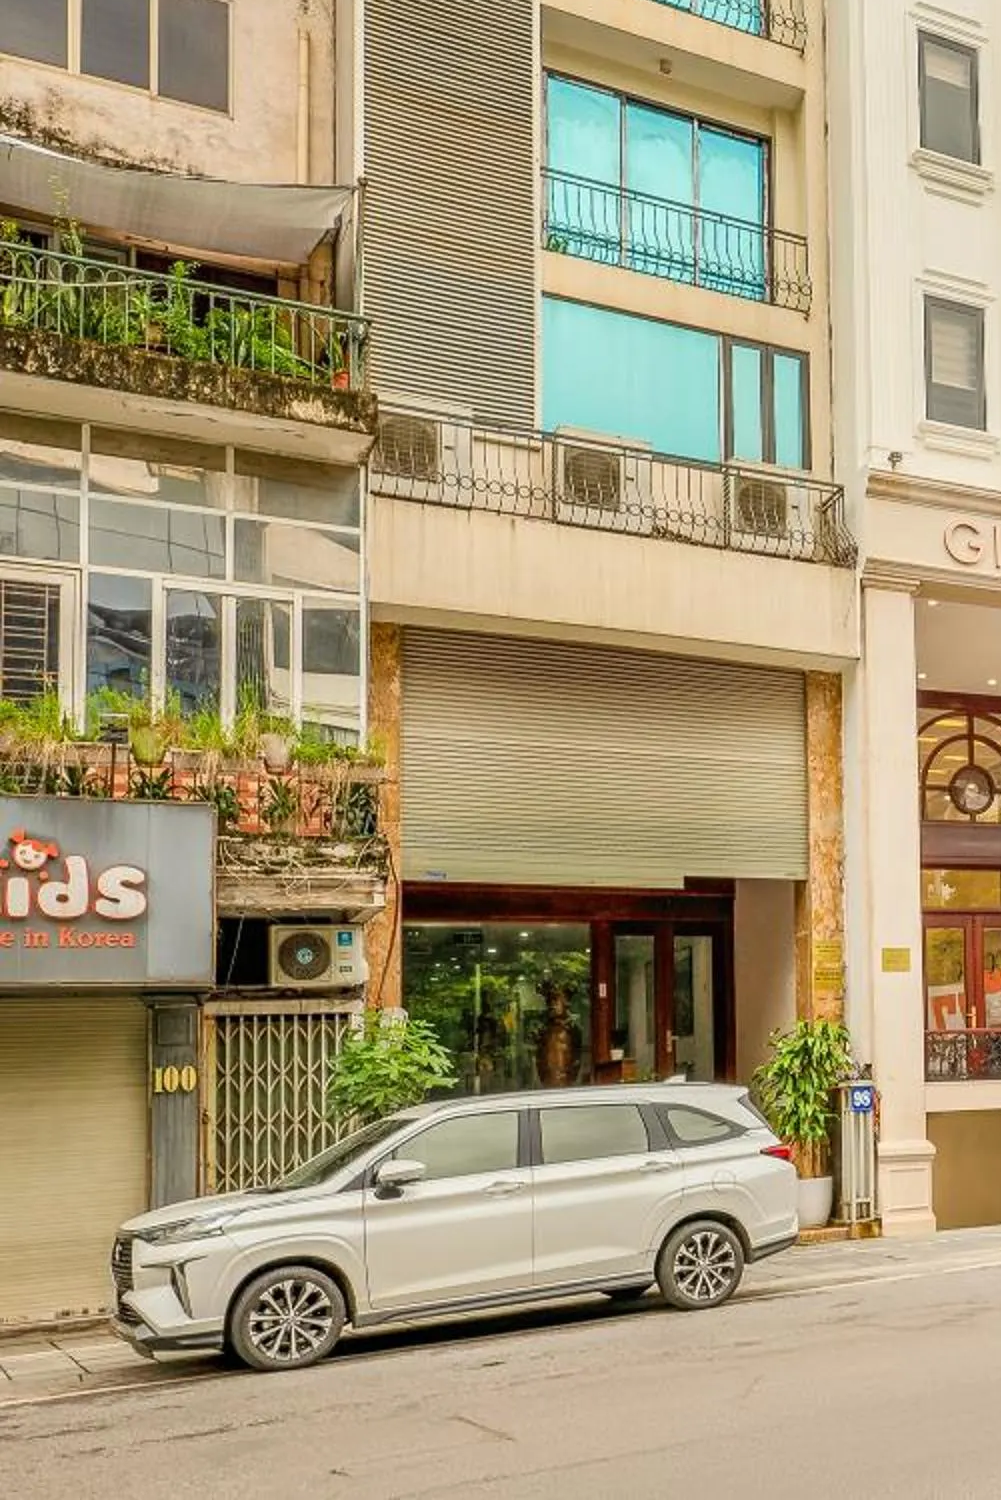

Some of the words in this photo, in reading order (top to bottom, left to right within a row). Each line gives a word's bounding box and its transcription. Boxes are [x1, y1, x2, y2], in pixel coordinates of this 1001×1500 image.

[0, 855, 148, 919] ids
[24, 928, 49, 948] in
[58, 927, 137, 949] Korea
[154, 1064, 197, 1093] 100
